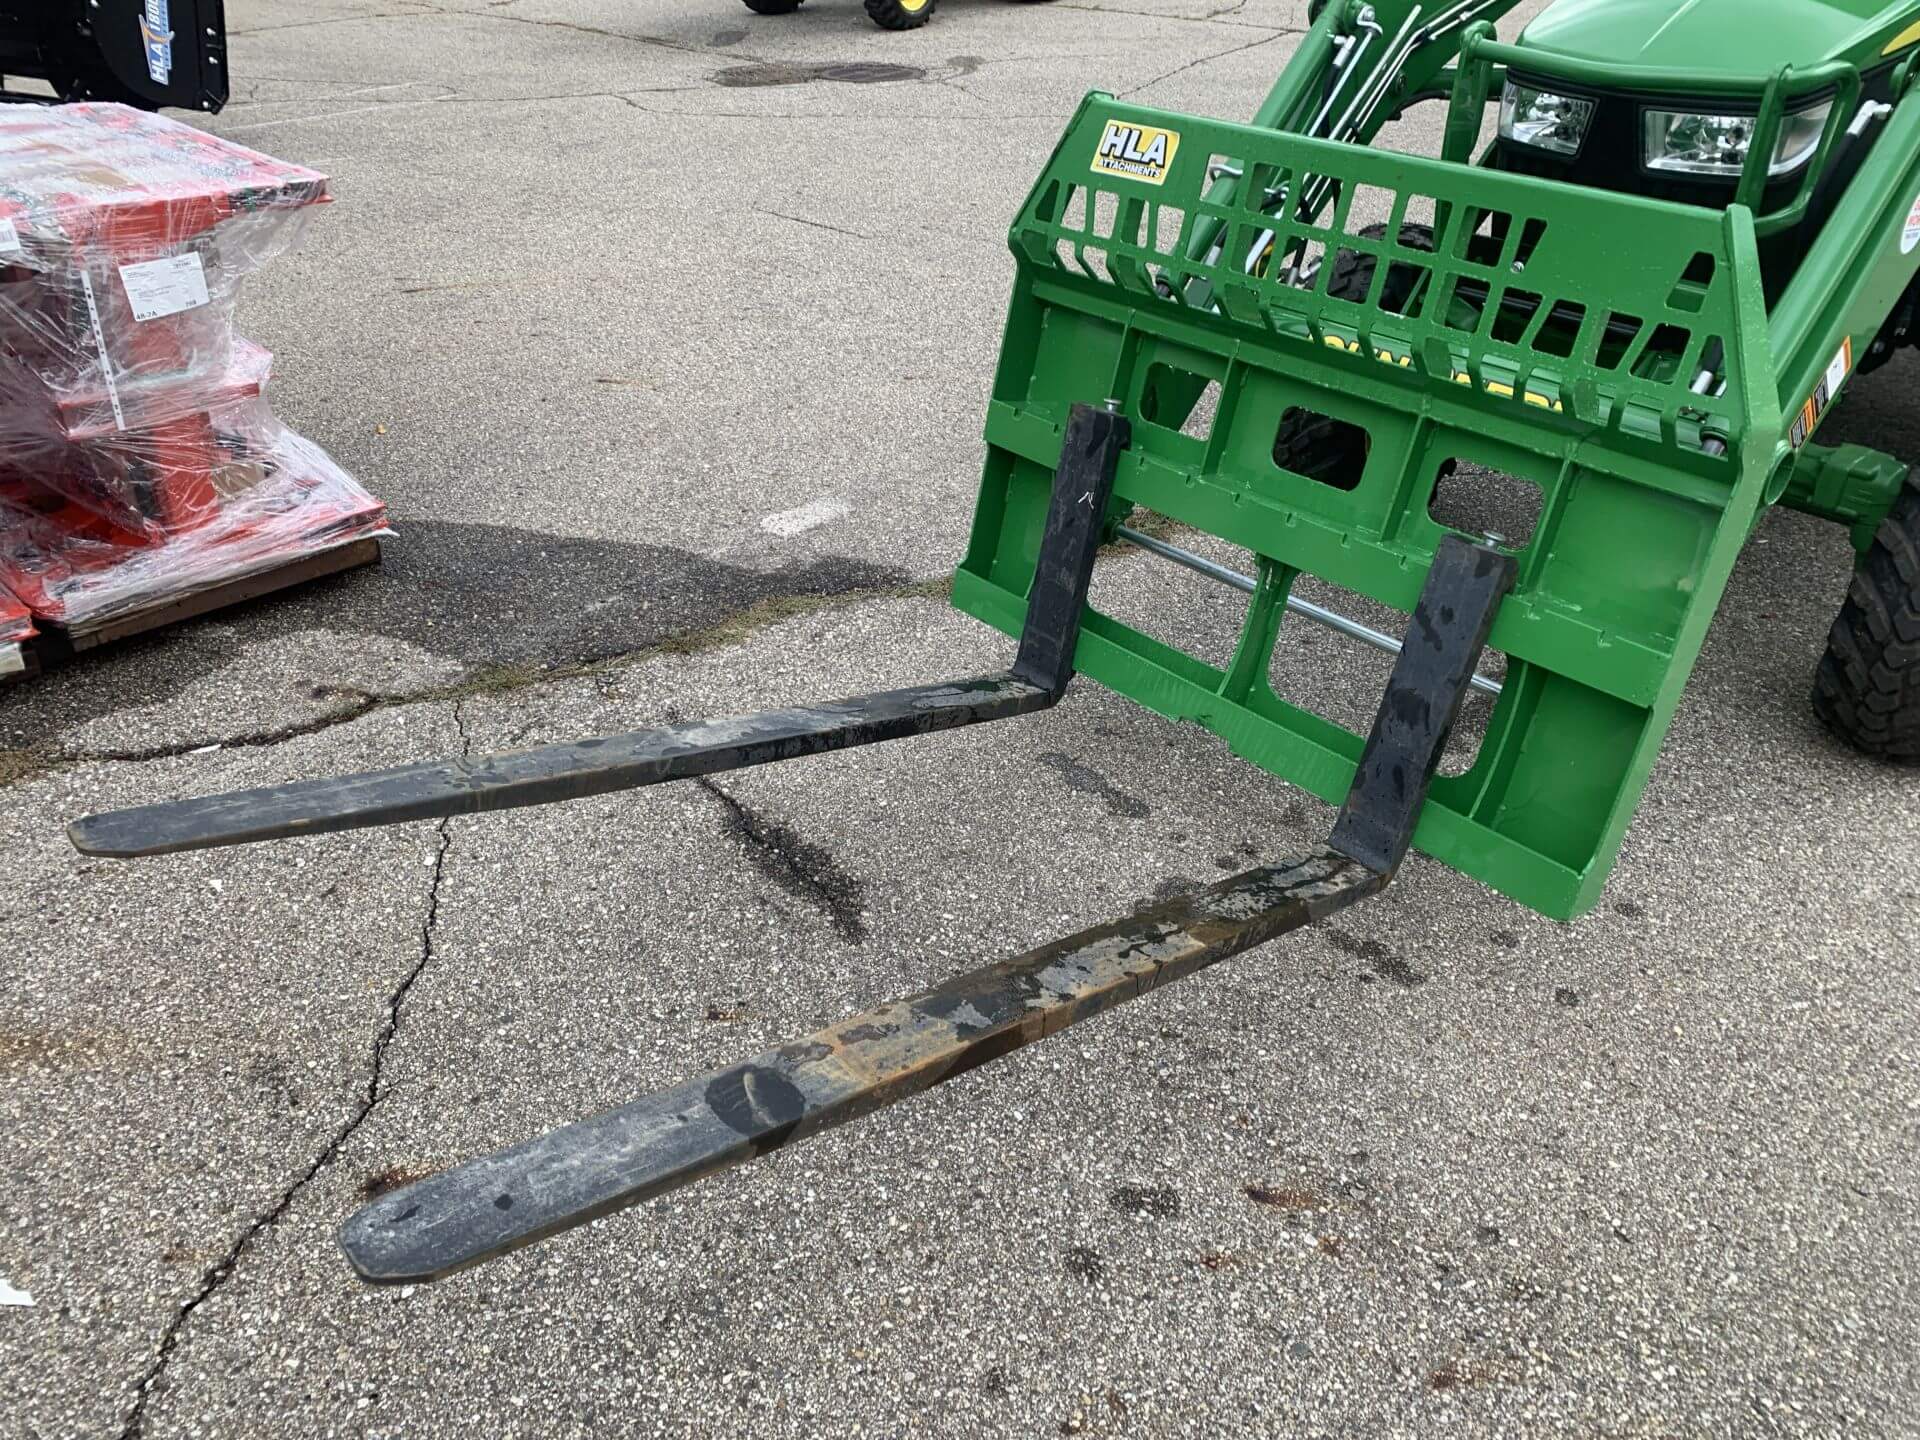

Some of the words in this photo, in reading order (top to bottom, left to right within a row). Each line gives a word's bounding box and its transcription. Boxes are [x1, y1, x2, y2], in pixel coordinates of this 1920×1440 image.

[150, 43, 165, 81] HLA
[1100, 124, 1168, 169] HLA
[1097, 157, 1162, 179] ATTACHMENTS
